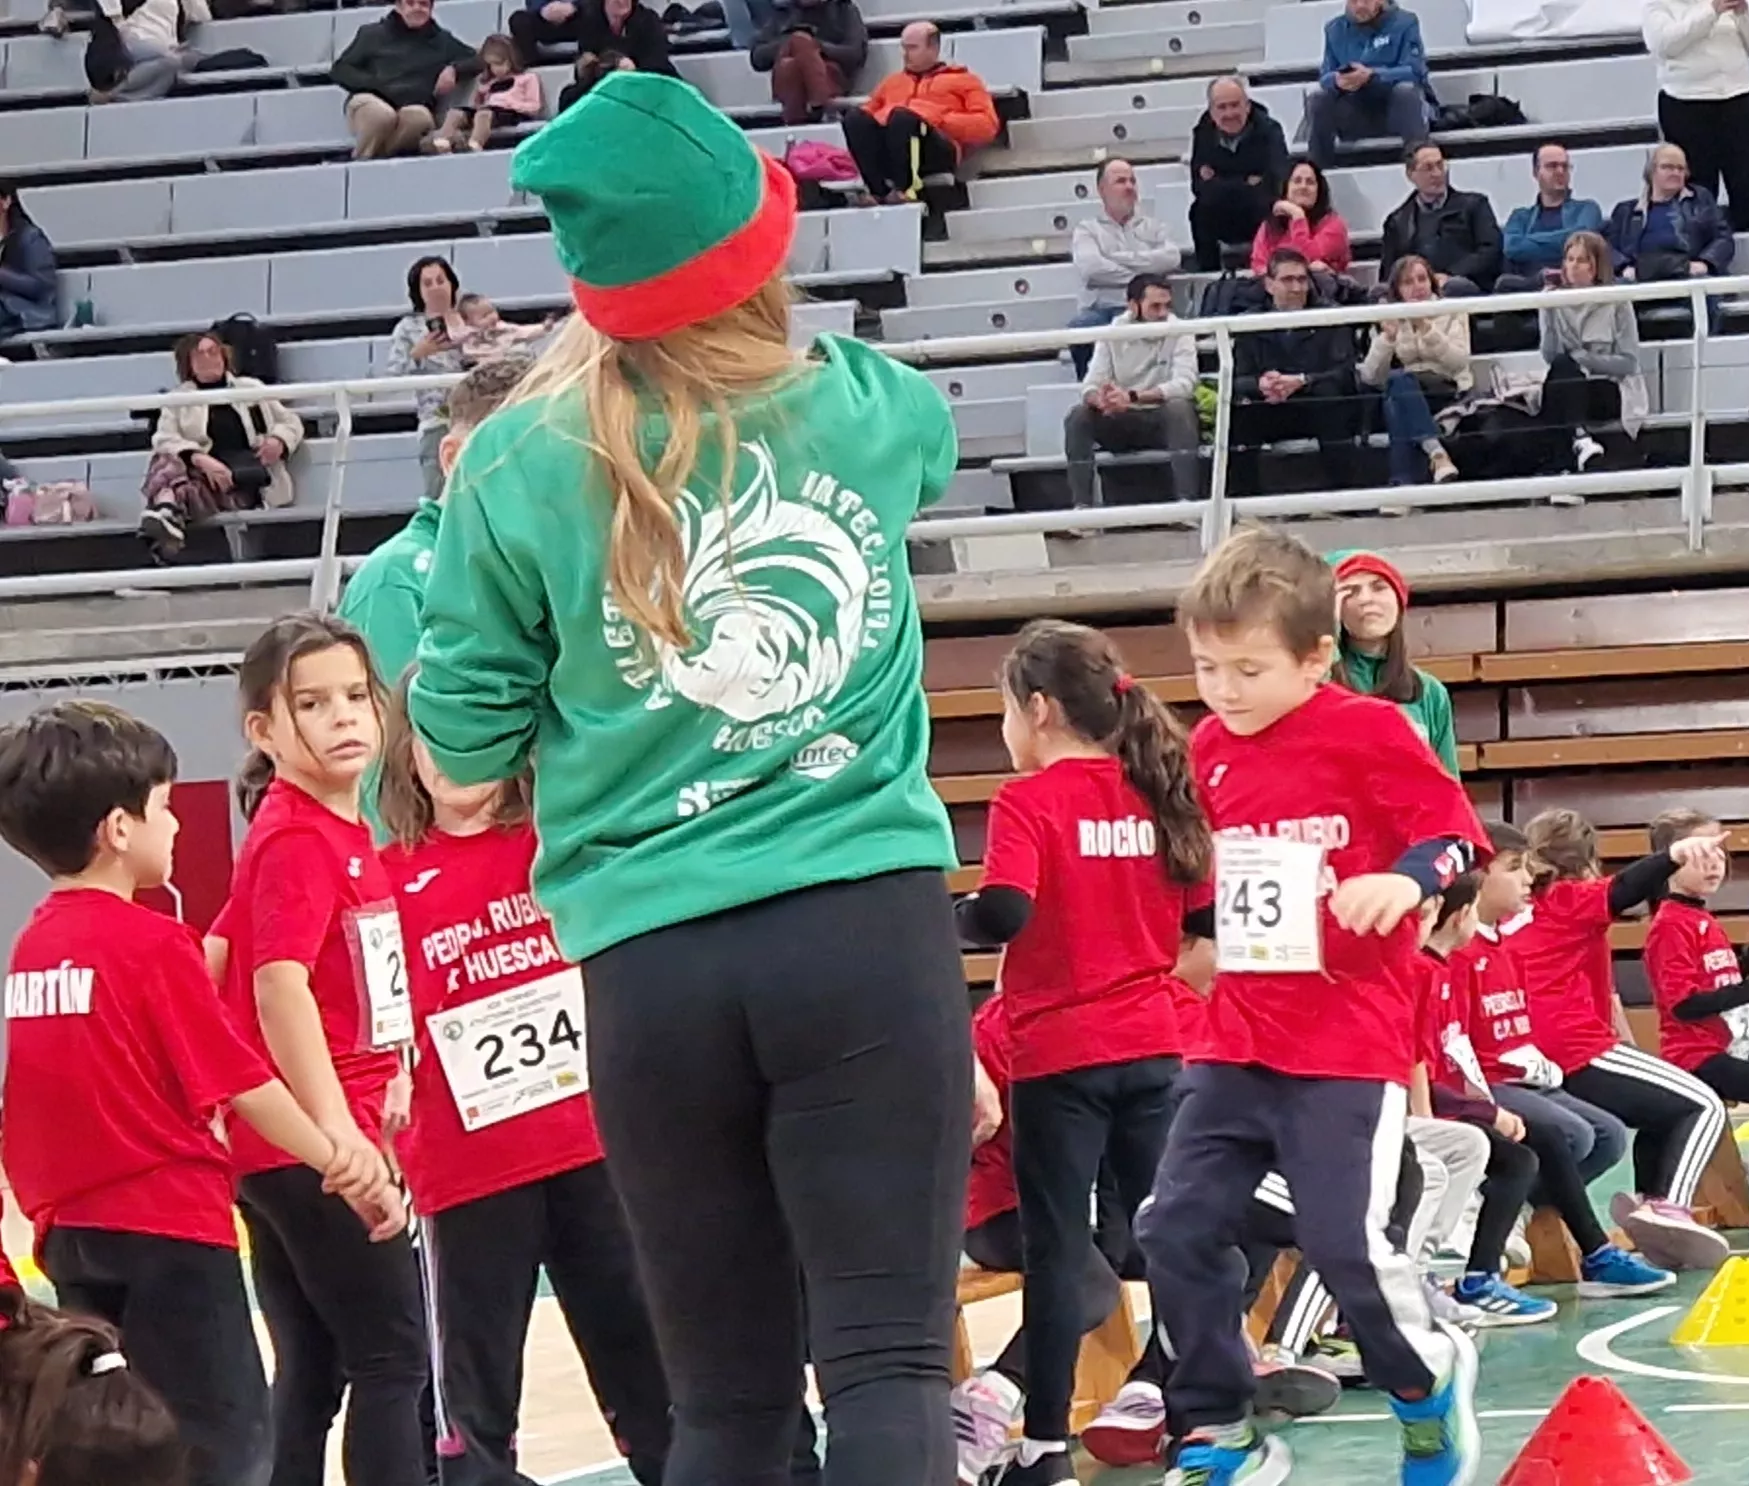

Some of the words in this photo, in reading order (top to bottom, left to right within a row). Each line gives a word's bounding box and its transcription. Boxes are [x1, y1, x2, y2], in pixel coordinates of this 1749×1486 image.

[1078, 814, 1157, 857] ROCÍO
[462, 933, 560, 985] HUESCA
[475, 1009, 582, 1081] 234
